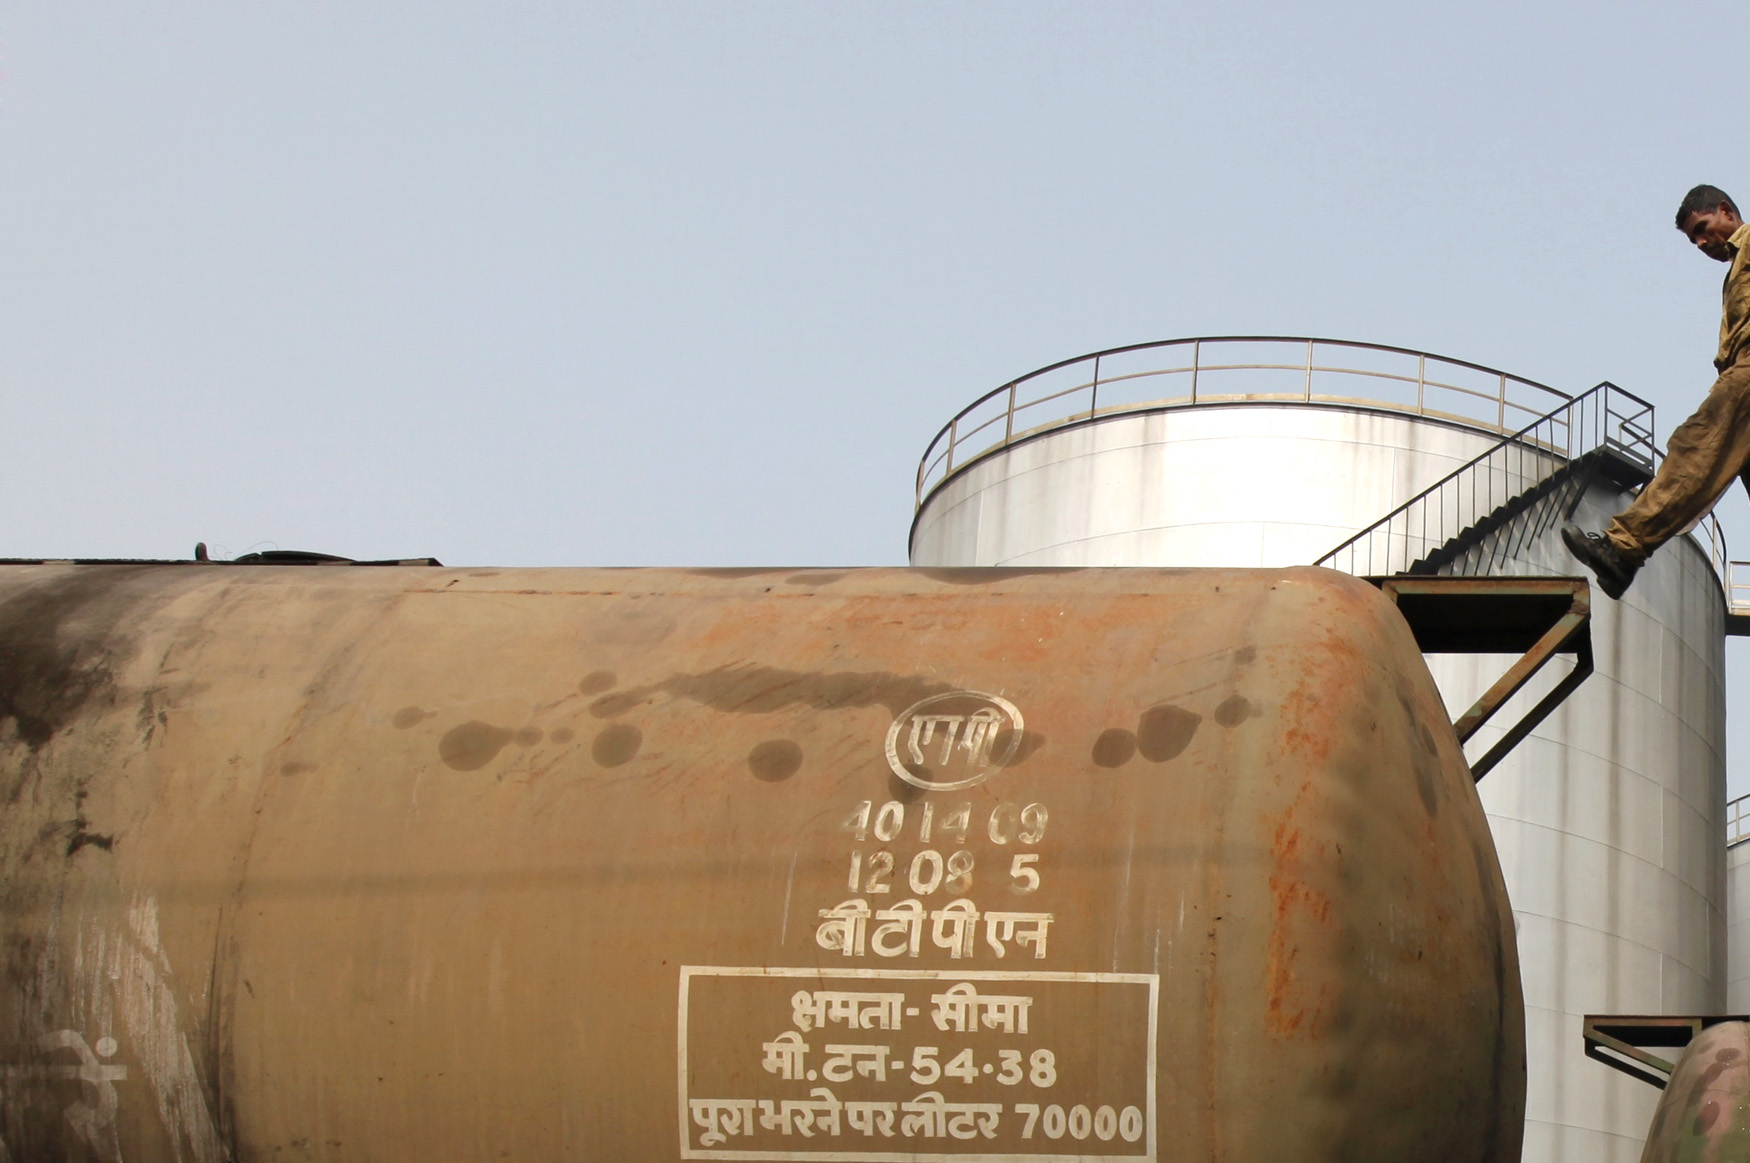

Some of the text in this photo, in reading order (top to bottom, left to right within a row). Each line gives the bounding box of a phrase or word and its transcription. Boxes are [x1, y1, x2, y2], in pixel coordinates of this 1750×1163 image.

[848, 850, 895, 893] 12
[1010, 854, 1040, 895] 5
[900, 1091, 1002, 1139] लीटर
[1014, 1103, 1143, 1142] 70000
